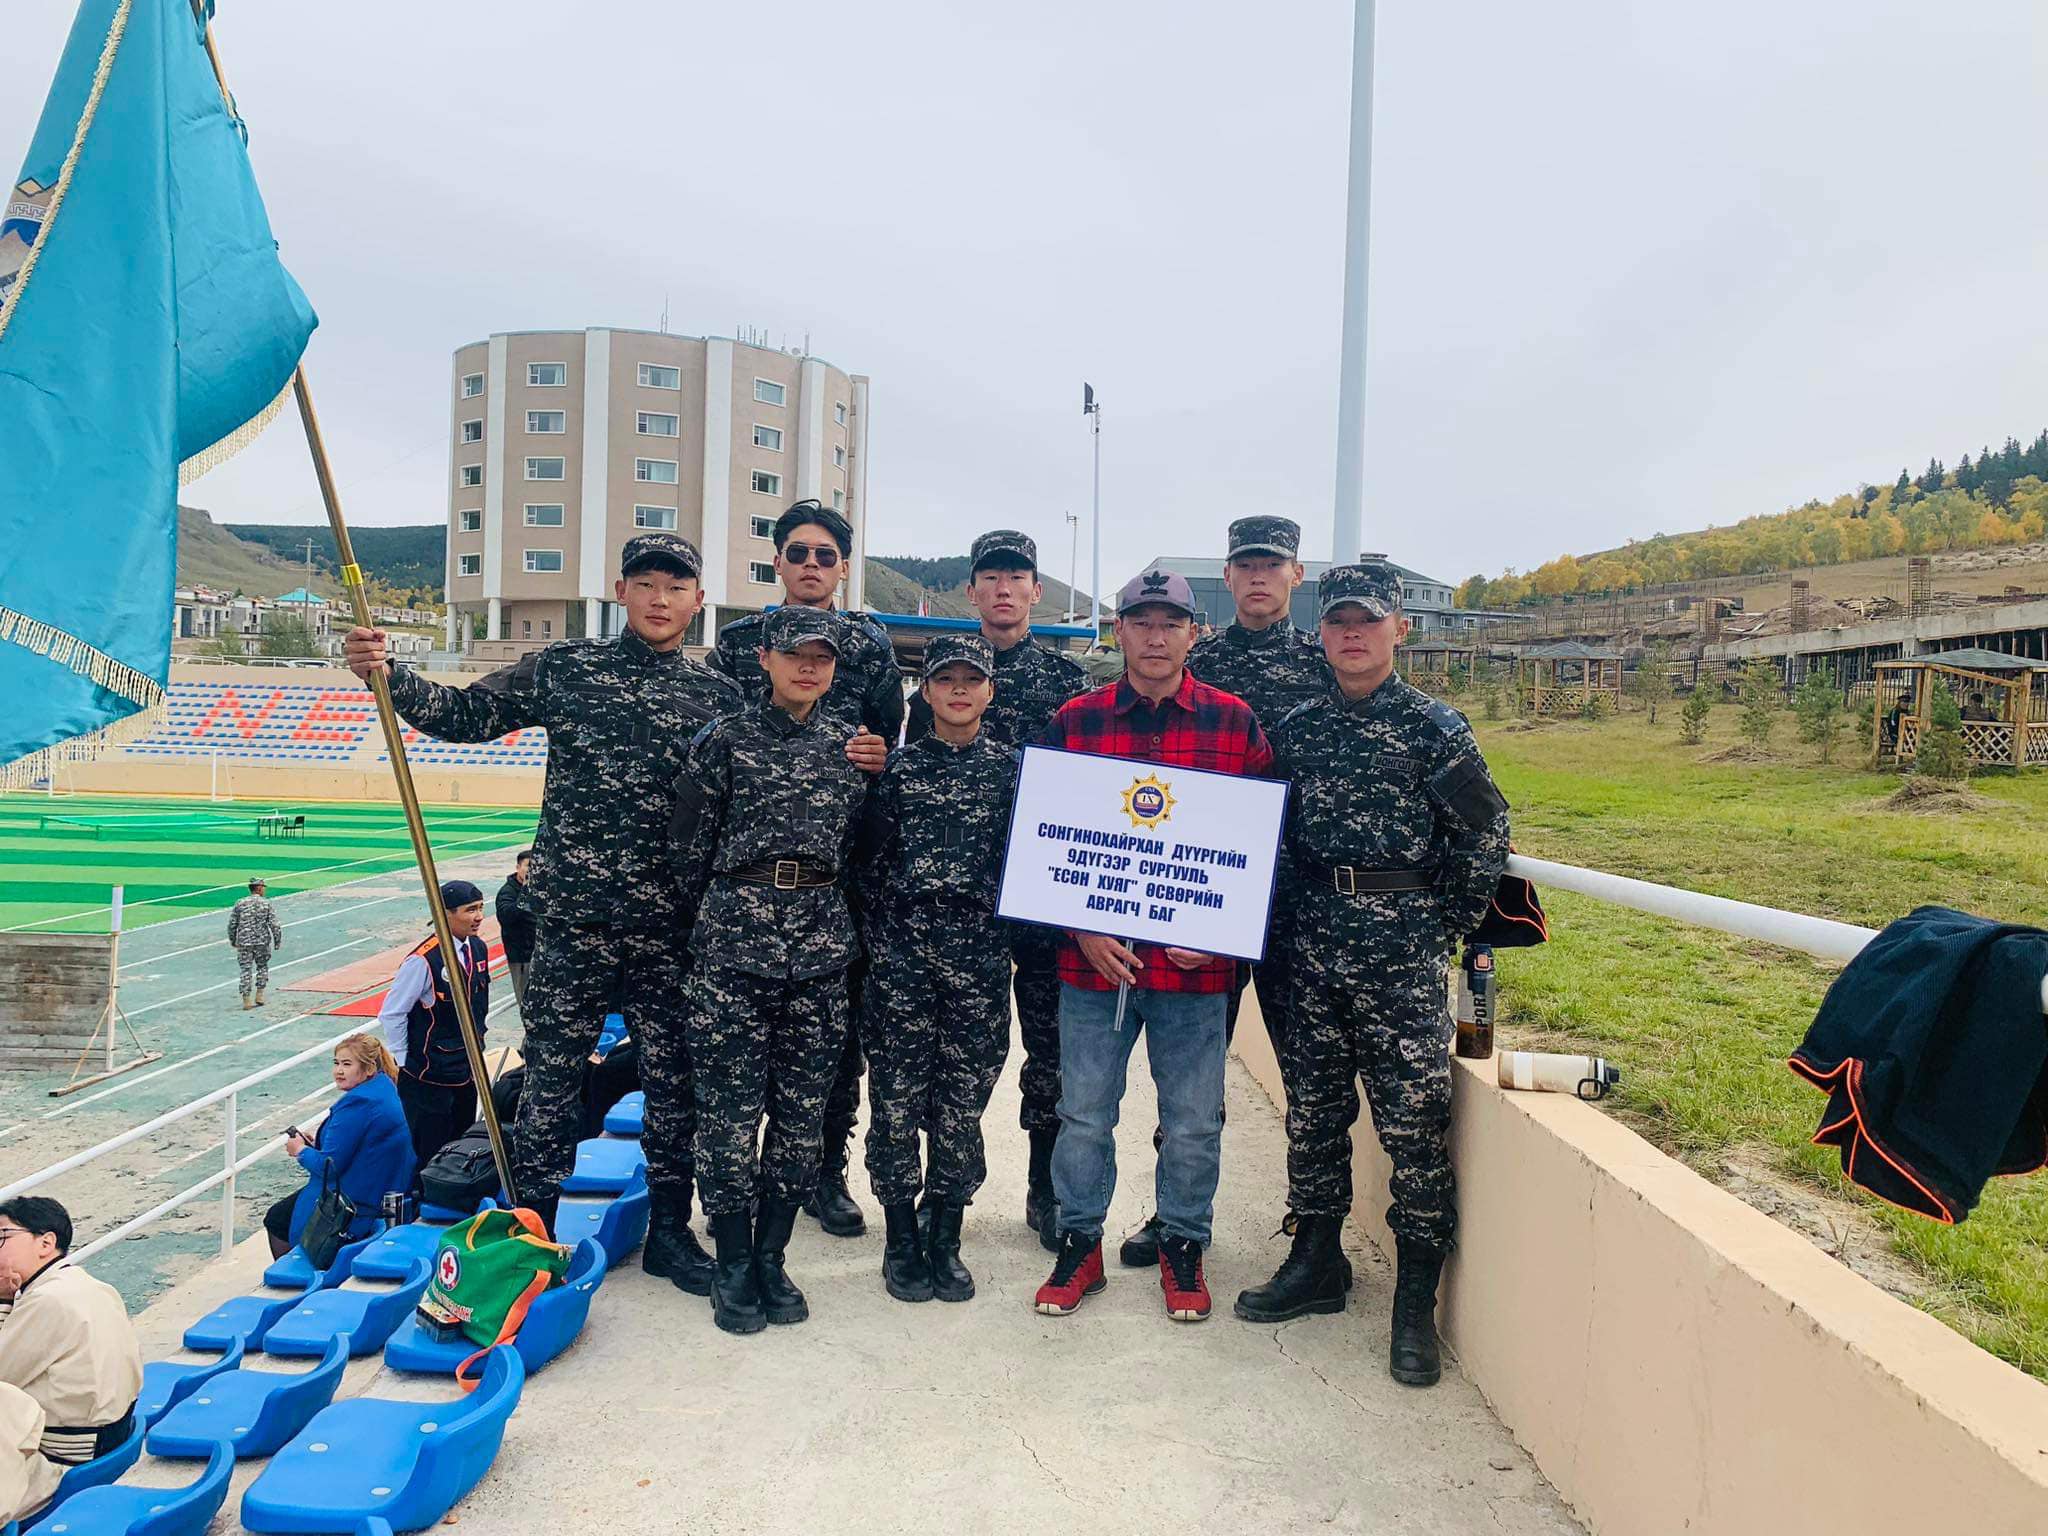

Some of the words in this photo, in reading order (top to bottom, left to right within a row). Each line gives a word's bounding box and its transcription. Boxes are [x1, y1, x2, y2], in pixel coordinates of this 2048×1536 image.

[1037, 823, 1164, 856] СОНГИНОХАЙРХАН
[1171, 844, 1248, 869] ДҮҮРГИЙН
[1048, 866, 1089, 886] "ЕСӨН
[1097, 874, 1139, 893] ХУЯГ"
[1146, 883, 1224, 909] ӨСВӨРИЙН
[1139, 860, 1208, 884] СУРГУУЛЬ
[1086, 895, 1140, 917] АВРАГЧ
[1149, 905, 1176, 922] БАГ
